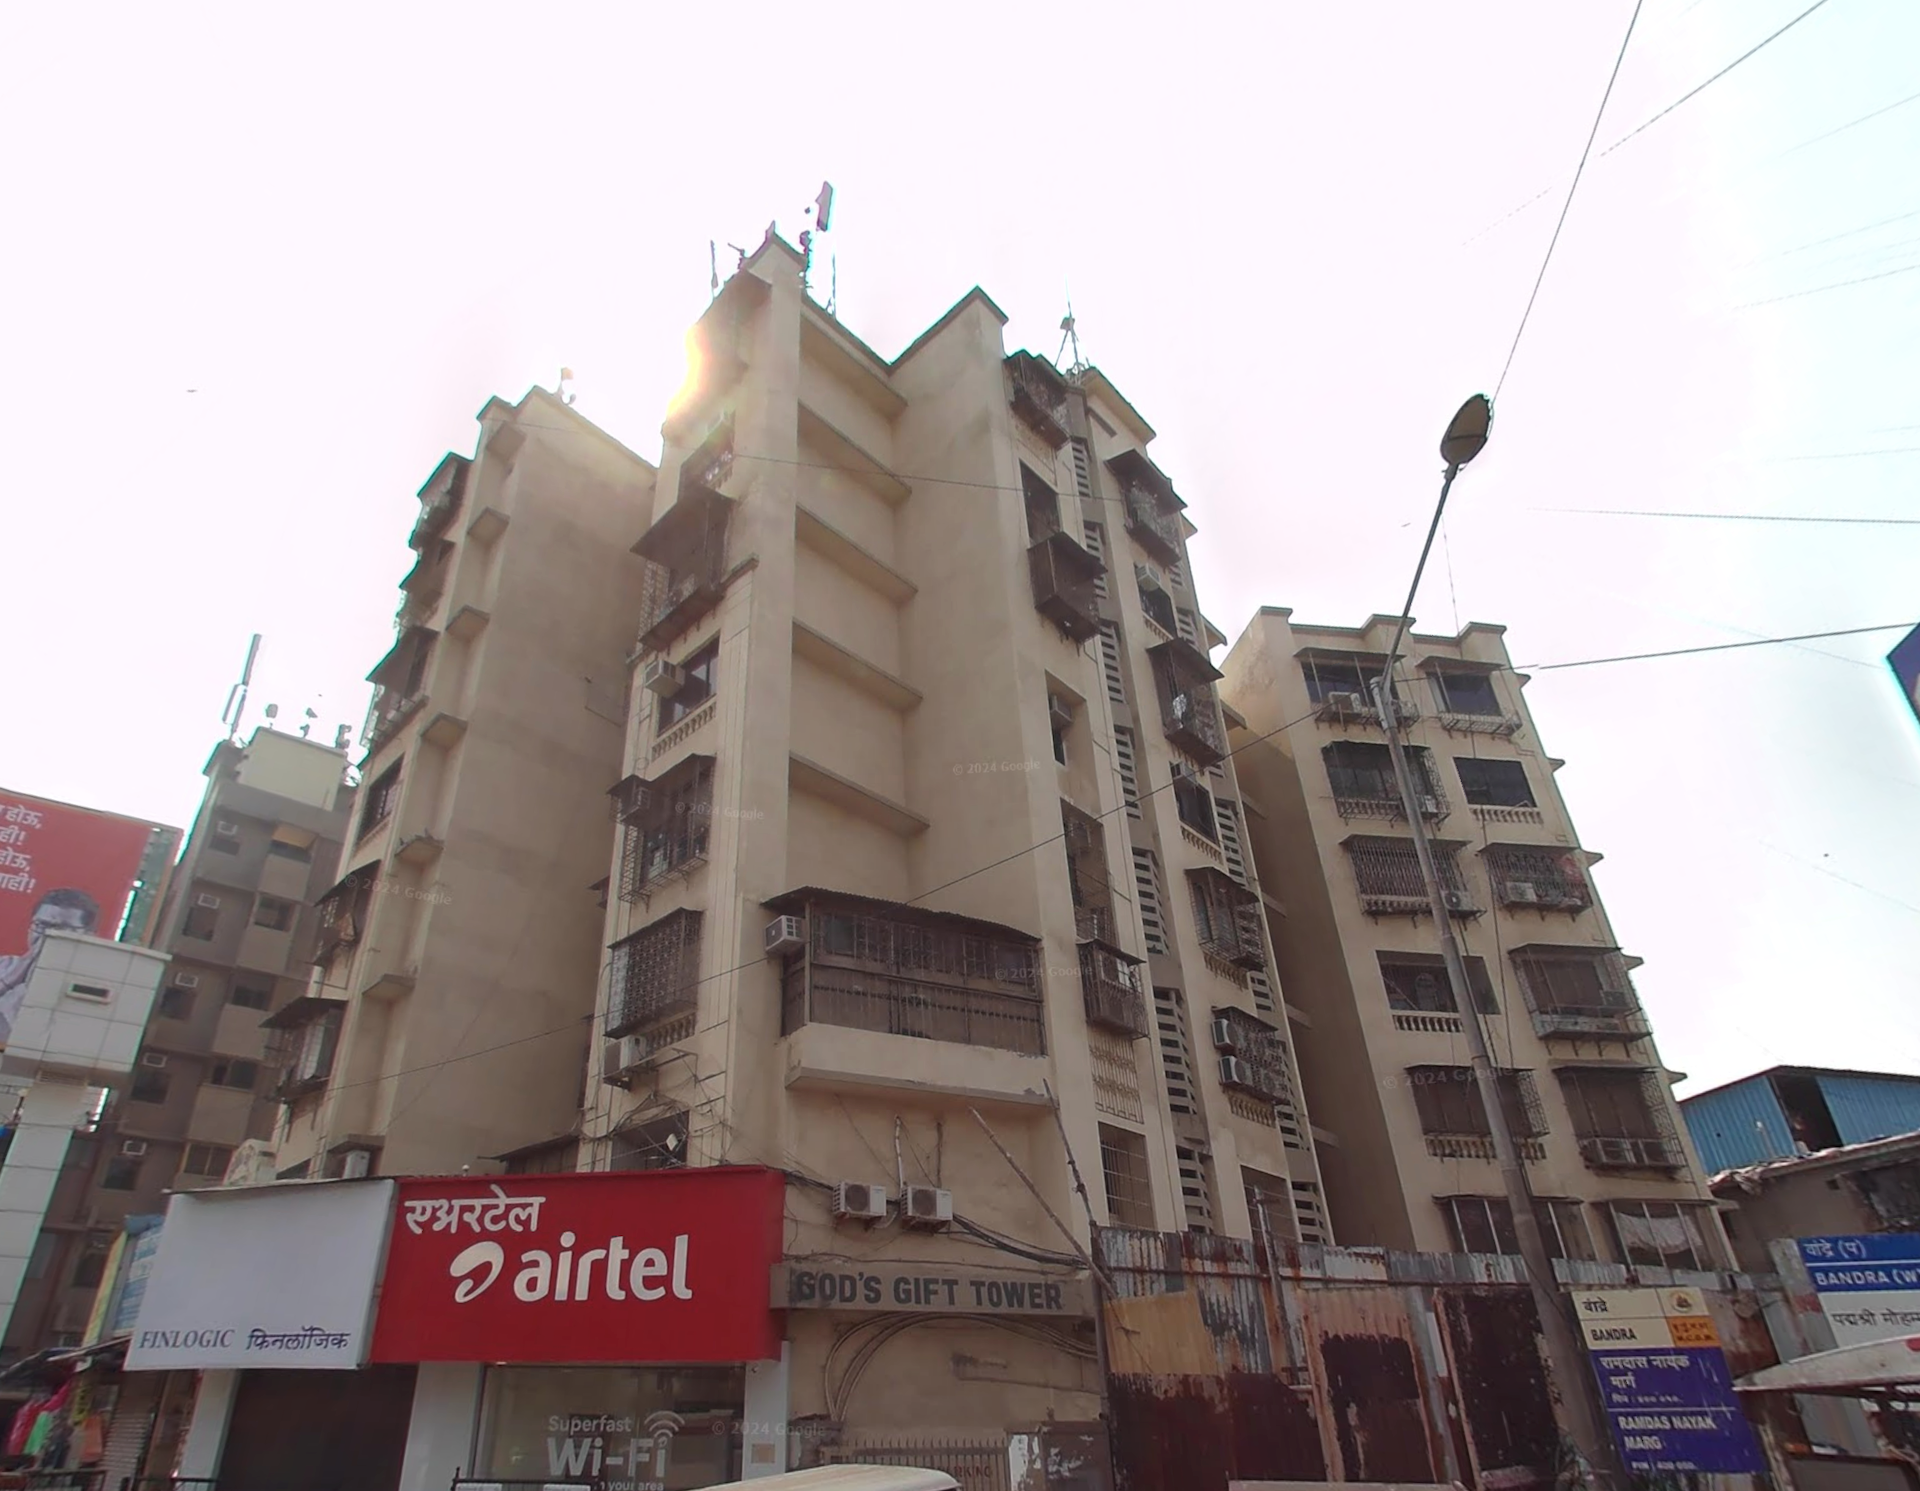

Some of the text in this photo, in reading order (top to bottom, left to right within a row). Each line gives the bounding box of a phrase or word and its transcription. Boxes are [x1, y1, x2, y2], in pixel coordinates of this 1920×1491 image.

[404, 1184, 546, 1234] एअरटेल
[513, 1231, 693, 1302] airtel
[1815, 1271, 1890, 1285] BANDRA
[795, 1270, 1063, 1310] GOD'S GIFT TOWER
[138, 1329, 236, 1349] FINLOGIC
[246, 1325, 351, 1350] फिनलॉजिक
[1591, 1328, 1638, 1341] BANDRA
[548, 1415, 632, 1436] Superfast
[1617, 1415, 1717, 1430] RAMDAS NAYAK
[1624, 1435, 1663, 1450] MARG
[547, 1436, 668, 1477] Wi-Fi
[638, 1481, 664, 1490] area
